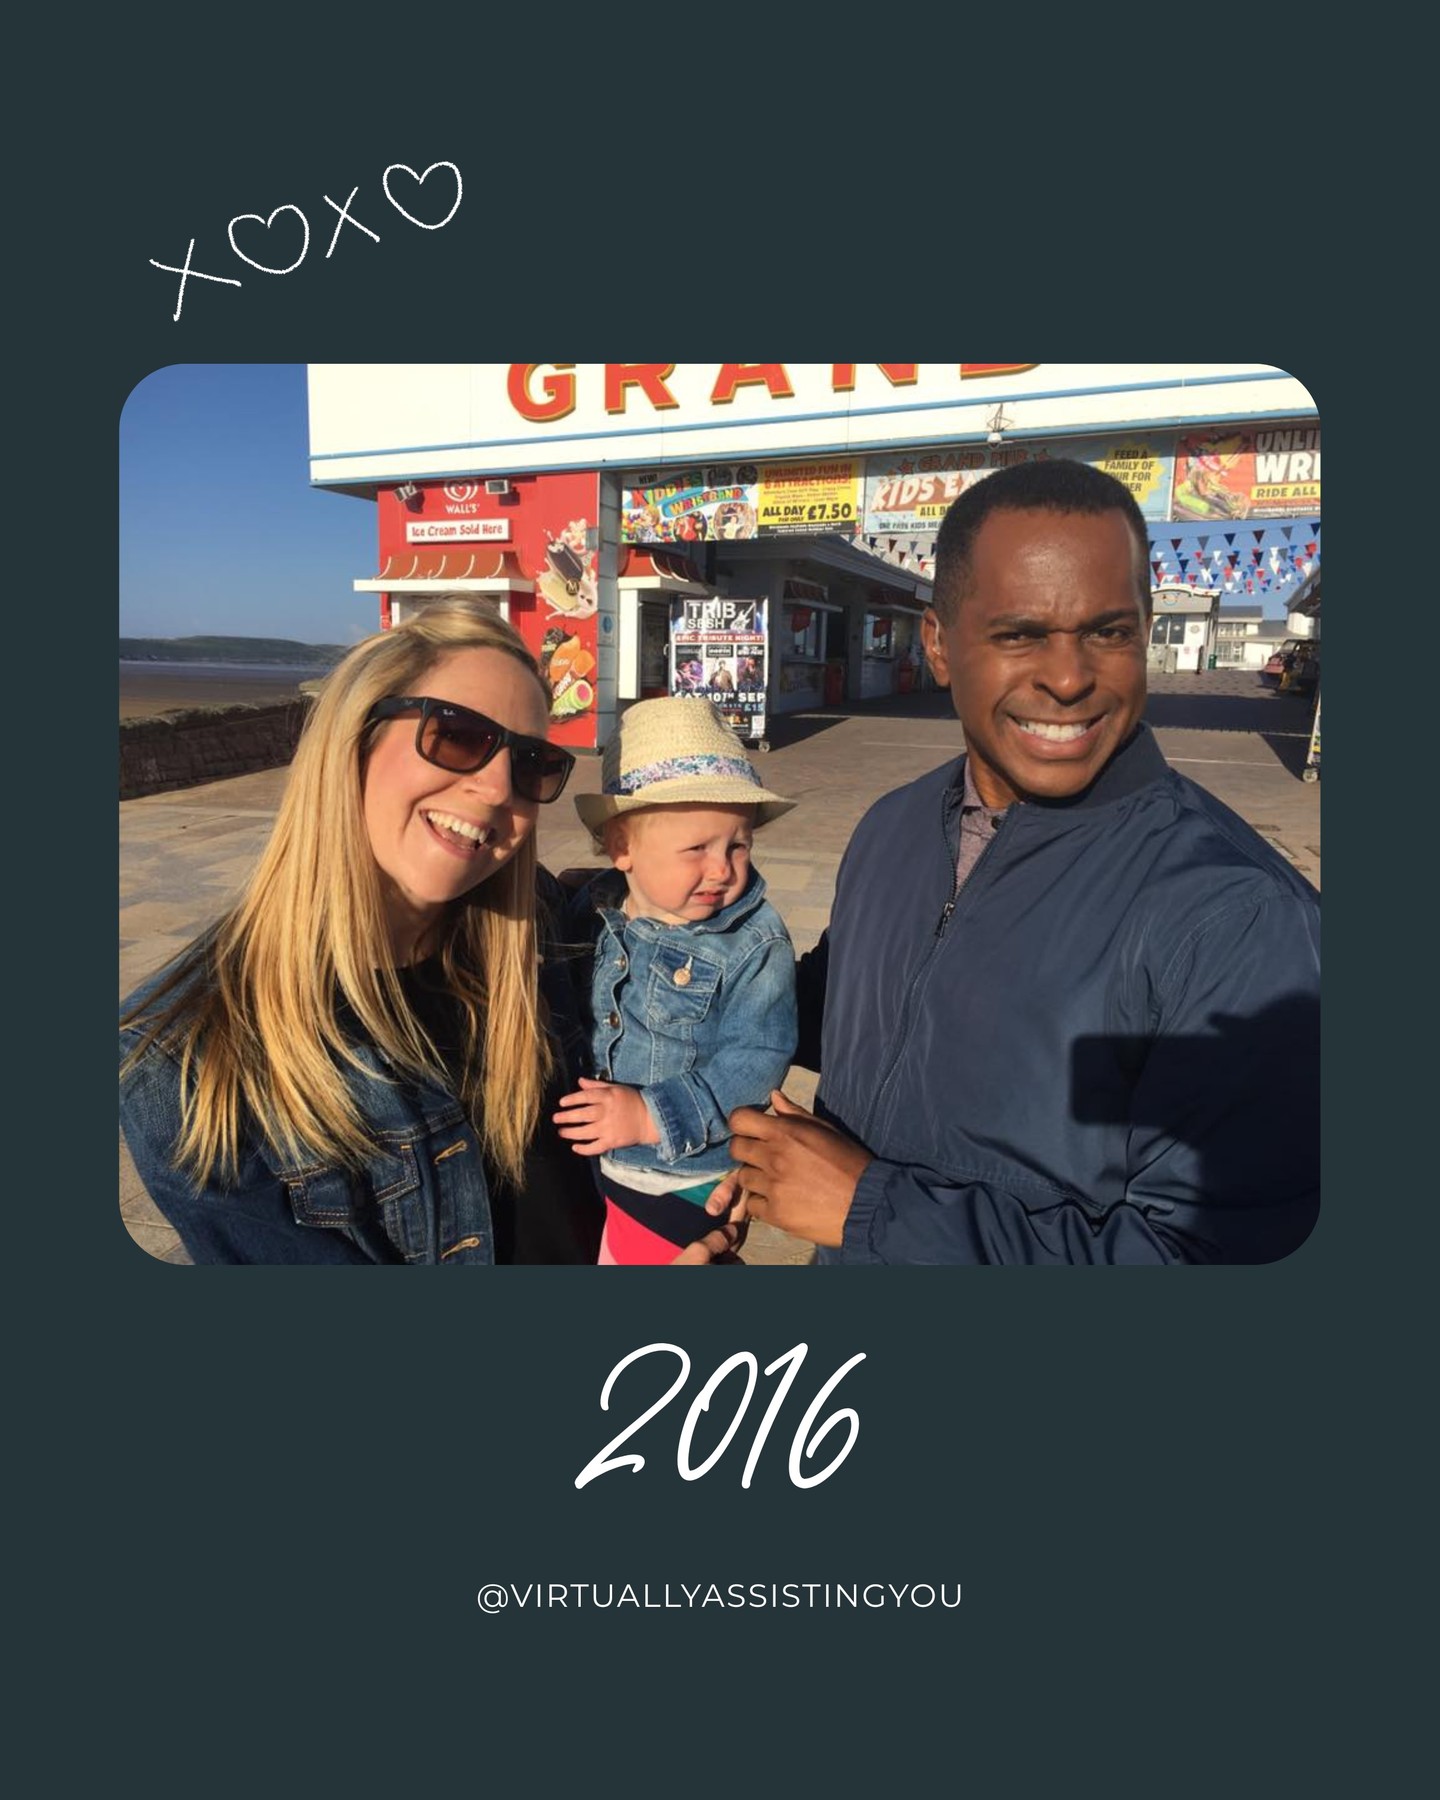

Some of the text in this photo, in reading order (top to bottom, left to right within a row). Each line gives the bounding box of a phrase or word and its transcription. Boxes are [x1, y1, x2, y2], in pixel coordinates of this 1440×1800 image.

[507, 363, 1041, 424] GRA
[1115, 450, 1148, 459] FEED A
[919, 452, 985, 471] GRAND
[1104, 460, 1155, 470] FAMILY OF
[764, 463, 852, 478] UNLIMITED FUN IN
[1108, 471, 1151, 481] OUR FOR
[773, 474, 852, 488] ATTRACTIONS!
[631, 470, 700, 508] KIDDIES
[871, 469, 994, 511] KIDS EA
[1256, 486, 1317, 498] RIDE ALL
[669, 487, 744, 516] WRISTBAND
[446, 503, 478, 514] WALL'S
[763, 503, 852, 520] ALL DAY £7.50
[920, 506, 936, 516] ALL
[412, 523, 502, 536] Ice Cream Sold Here
[688, 602, 736, 619] TRIB
[688, 619, 725, 629] SESH
[738, 692, 765, 702] SEP
